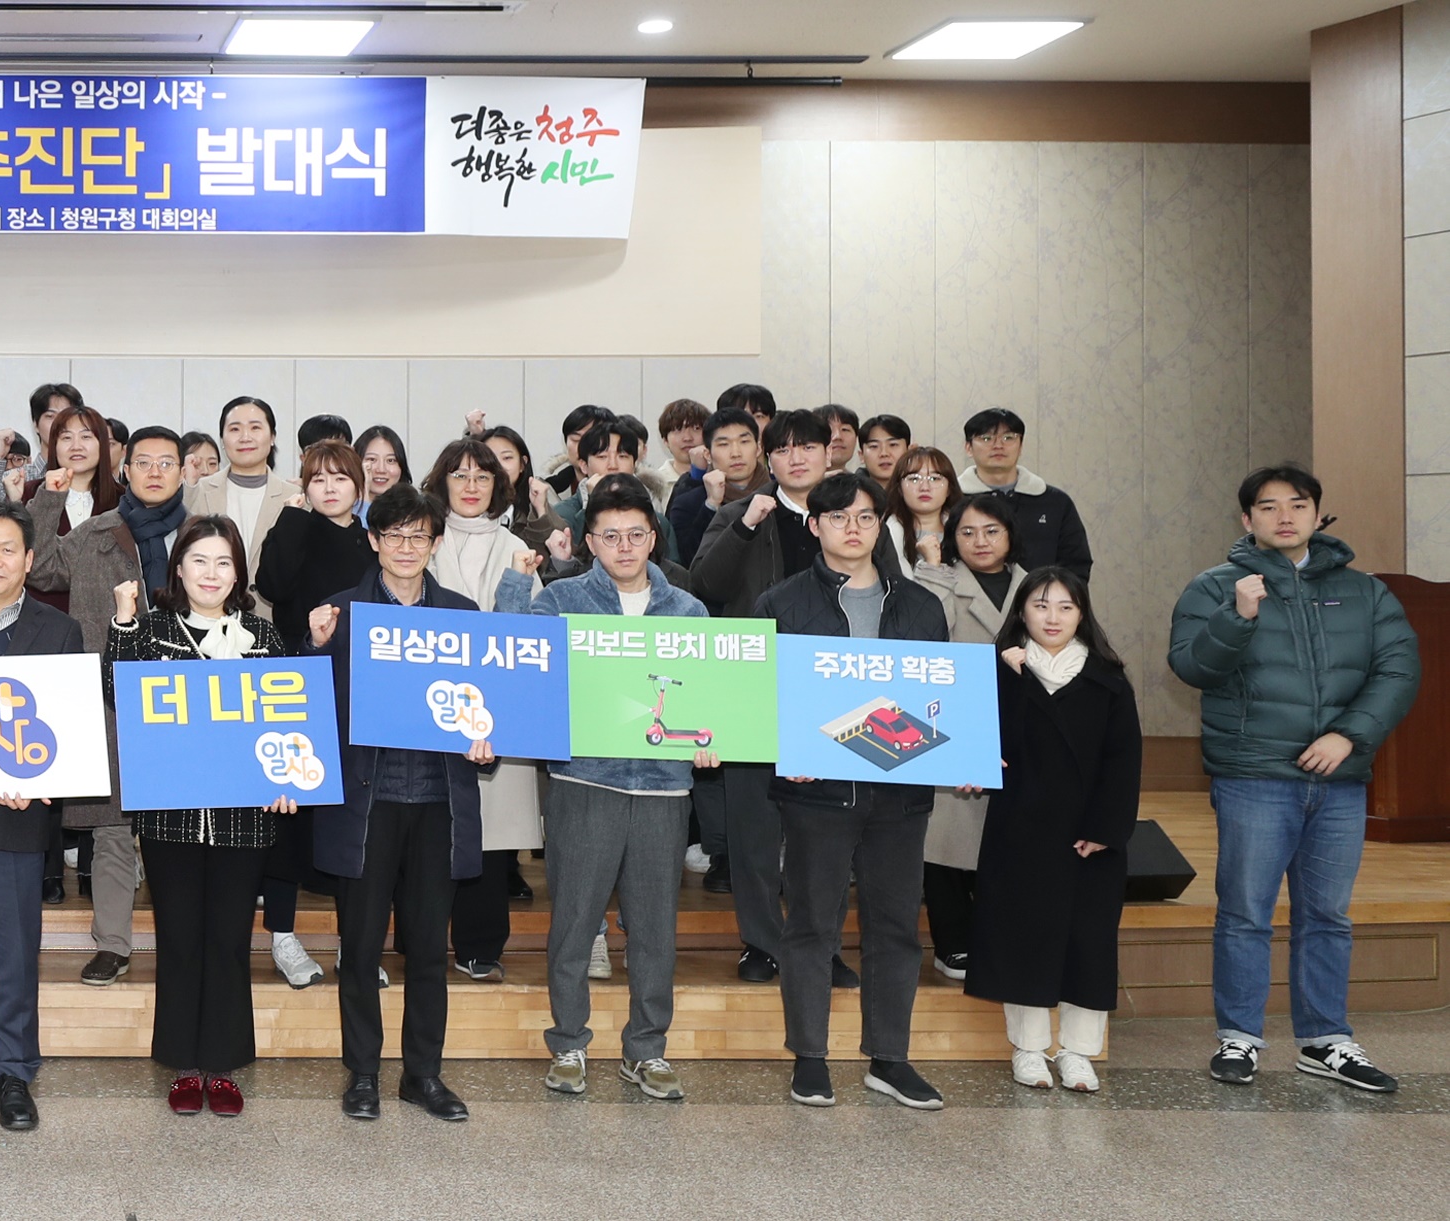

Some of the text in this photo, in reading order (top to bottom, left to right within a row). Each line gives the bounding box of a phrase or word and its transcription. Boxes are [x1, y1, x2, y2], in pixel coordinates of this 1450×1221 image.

[13, 80, 64, 109] 나은
[71, 80, 146, 110] 일상의
[152, 80, 205, 110] 시작
[535, 104, 620, 147] 청주
[196, 127, 387, 197] 발대식
[451, 145, 614, 208] 행복한 시민
[60, 207, 136, 230] 청원구청
[142, 208, 217, 230] 대회의실
[368, 627, 551, 672] 일상의 시작
[571, 630, 768, 663] 킥보드 방치 해결
[814, 652, 956, 685] 주차장 확충
[142, 672, 308, 724] 더 나은
[930, 703, 939, 717] P
